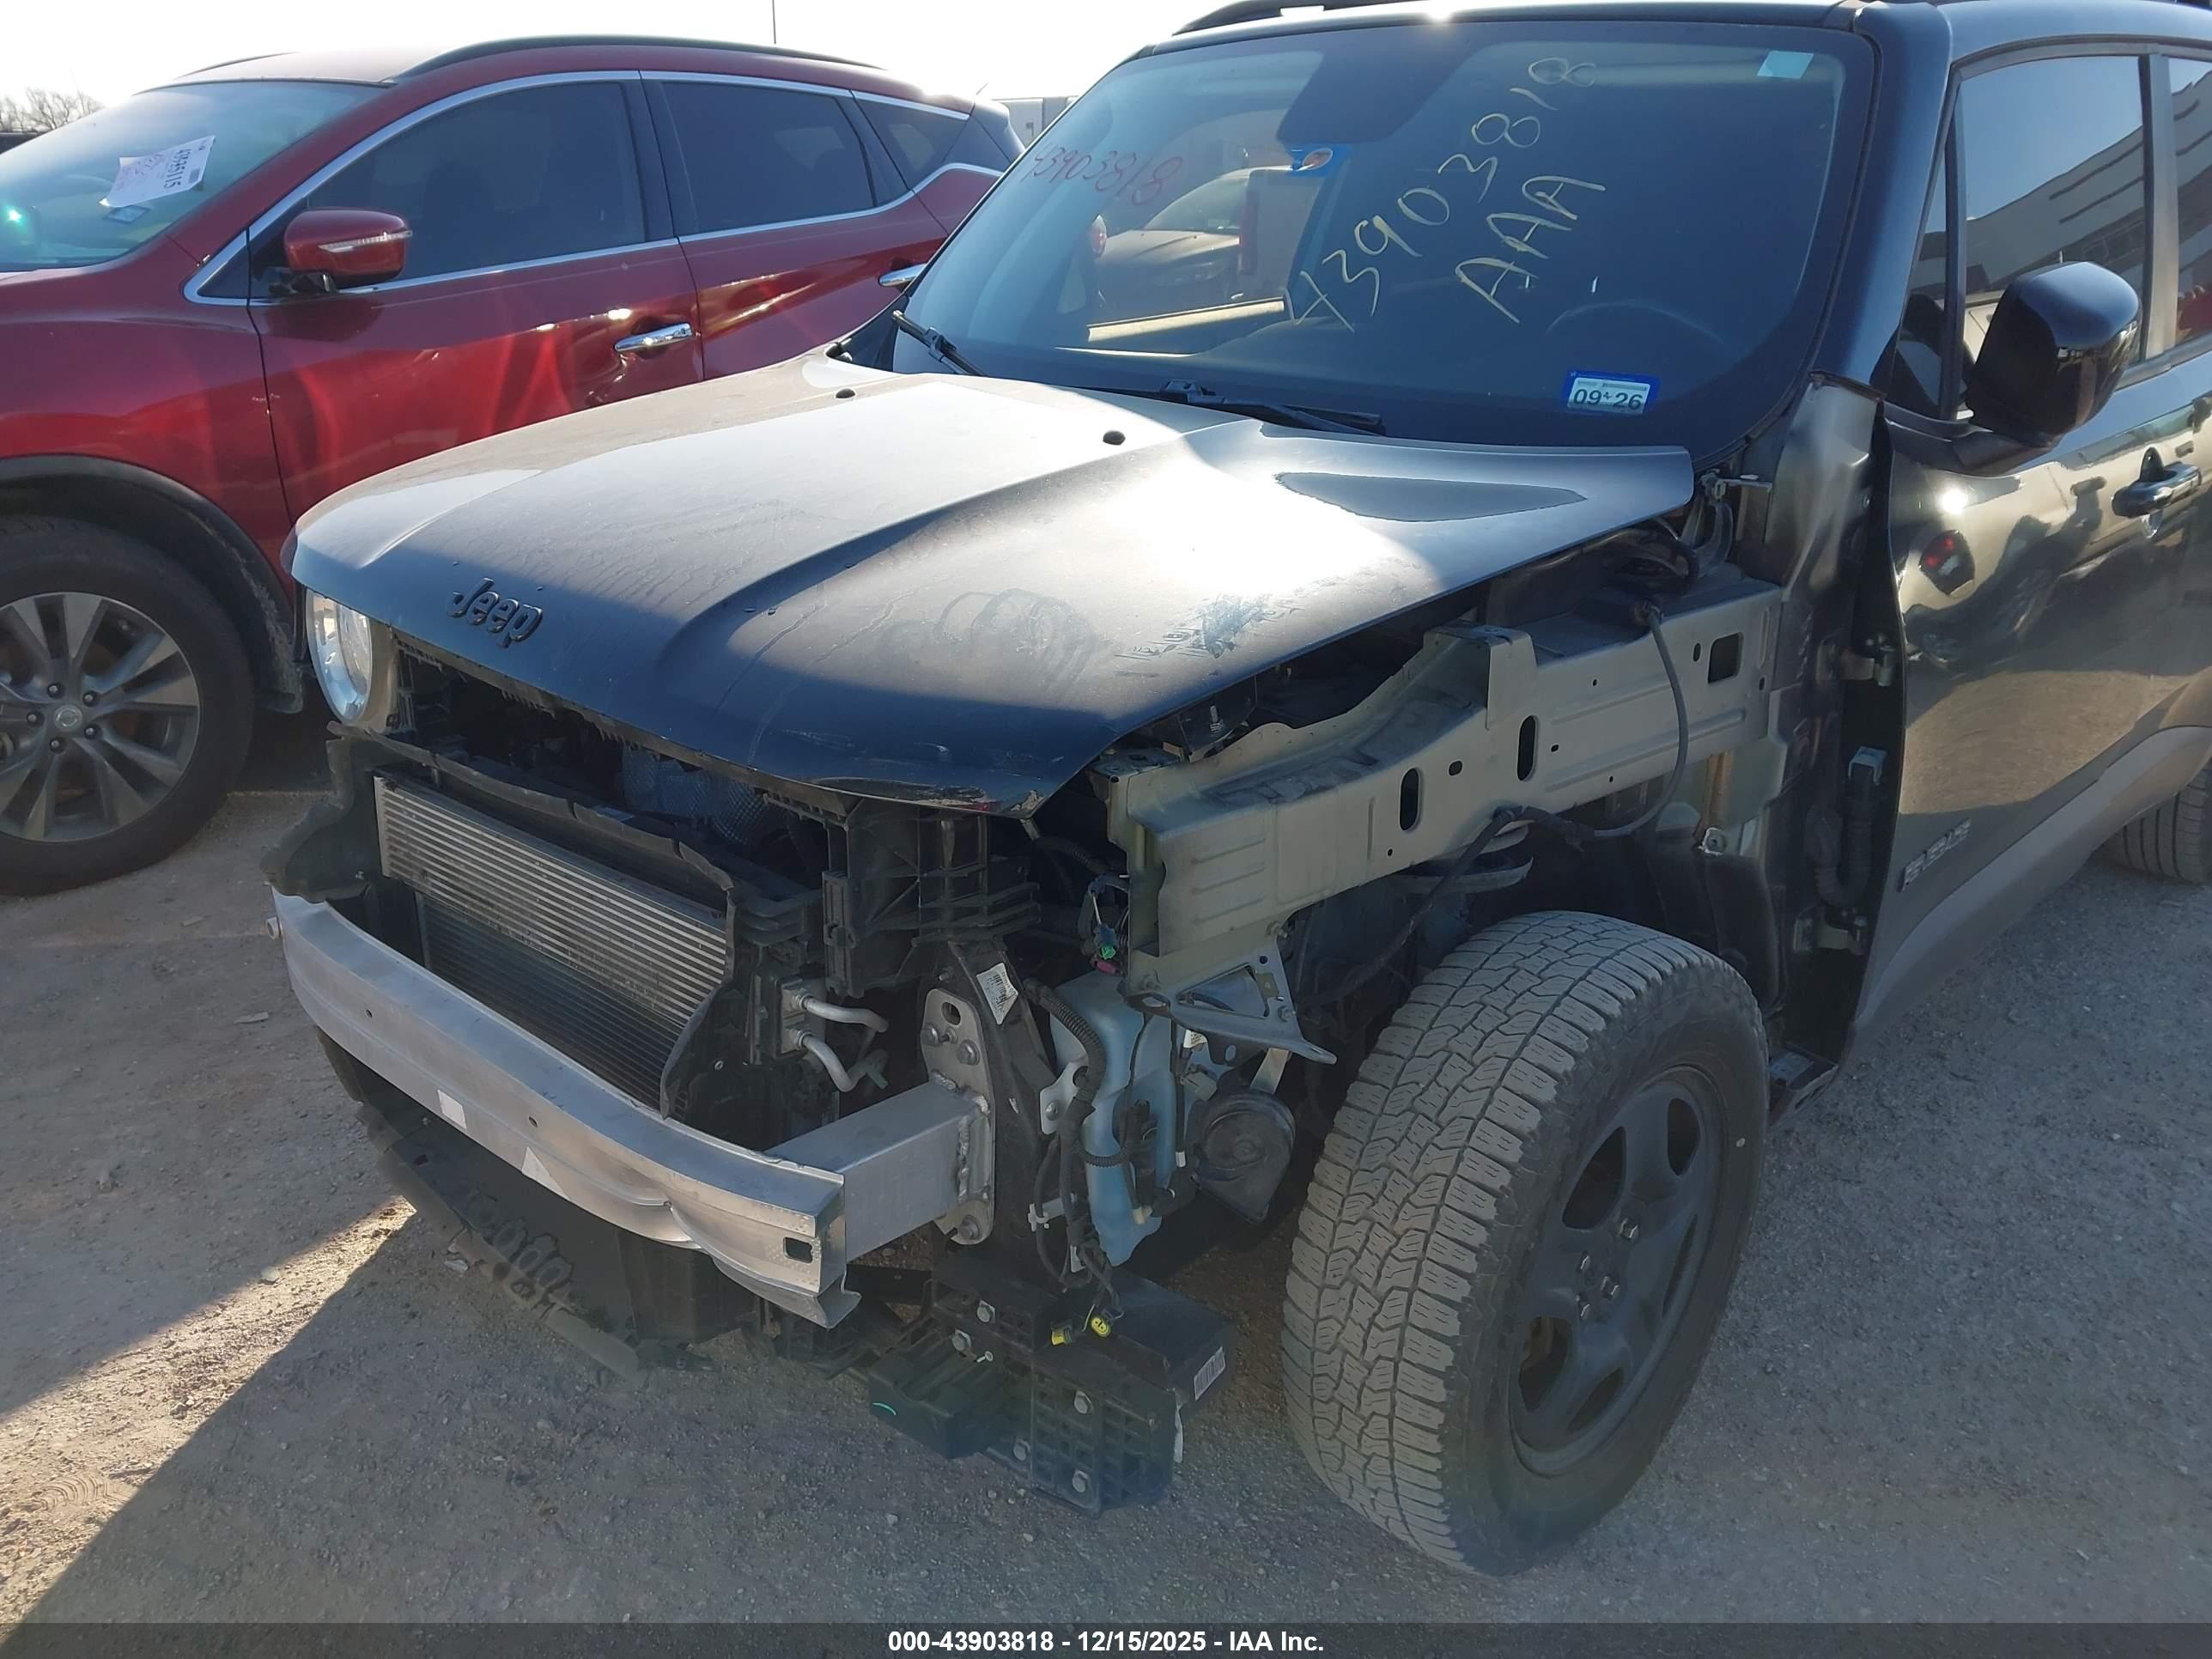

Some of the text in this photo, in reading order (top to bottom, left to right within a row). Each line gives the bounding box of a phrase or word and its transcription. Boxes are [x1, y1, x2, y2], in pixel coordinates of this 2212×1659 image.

[1020, 143, 1183, 206] 43903818
[1285, 58, 1595, 332] 43903818
[1455, 175, 1606, 324] AAA
[1573, 388, 1644, 410] 09 26
[447, 578, 543, 648] Jeep
